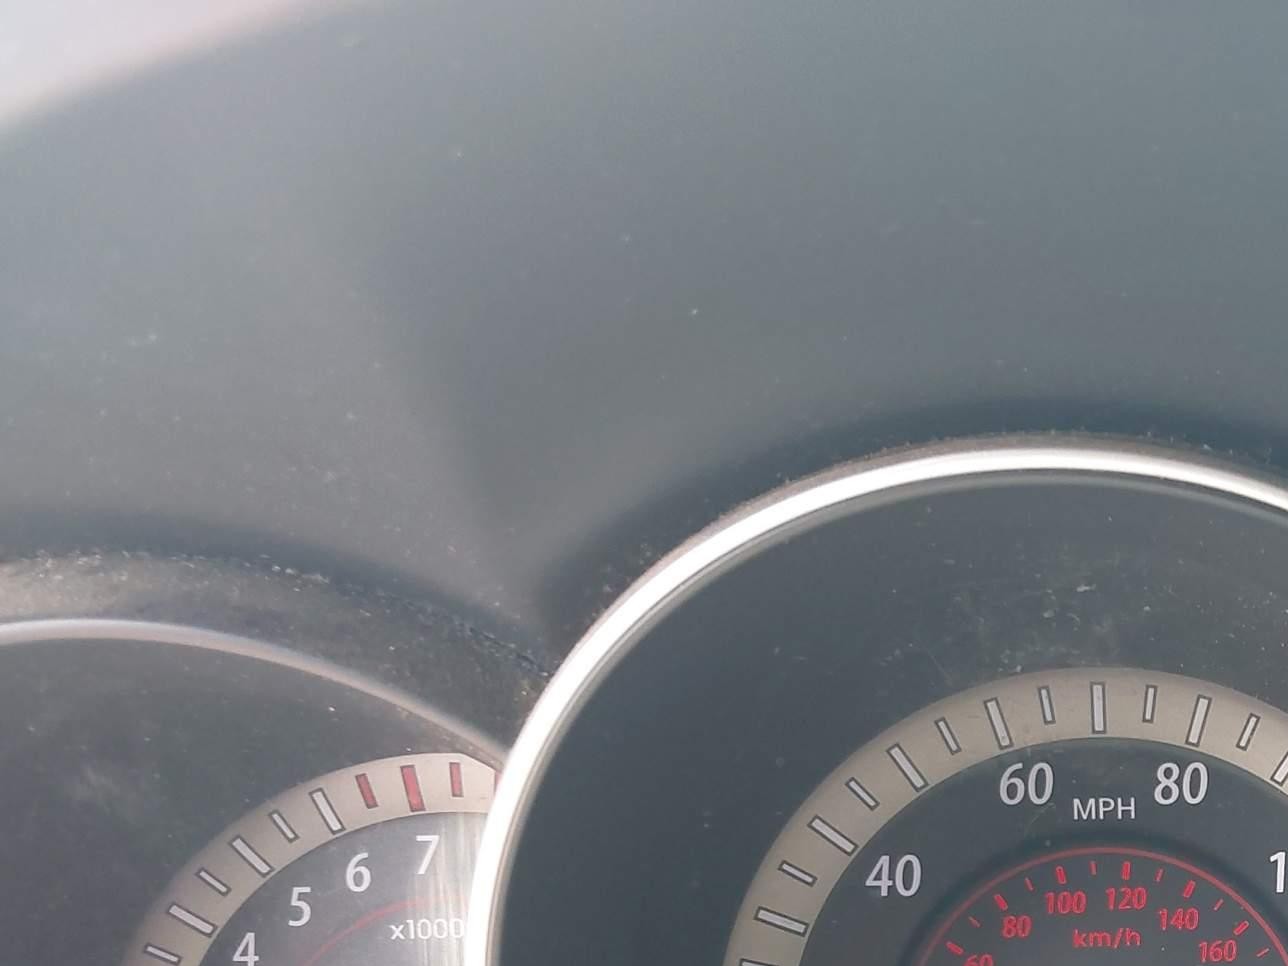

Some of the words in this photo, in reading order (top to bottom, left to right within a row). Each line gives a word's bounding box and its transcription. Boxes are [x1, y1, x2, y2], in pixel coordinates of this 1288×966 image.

[1000, 762, 1055, 805] 60
[1154, 762, 1208, 806] 80
[1072, 797, 1136, 820] MPH
[415, 835, 439, 875] 7
[345, 853, 371, 892] 6
[865, 854, 922, 897] 40
[288, 886, 312, 927] 5
[1046, 891, 1086, 915] 100
[1106, 887, 1147, 911] 120
[389, 919, 465, 940] x1000
[1002, 915, 1031, 939] 80
[1158, 908, 1199, 931] 140
[1072, 926, 1142, 949] km/h
[1199, 940, 1237, 964] 160
